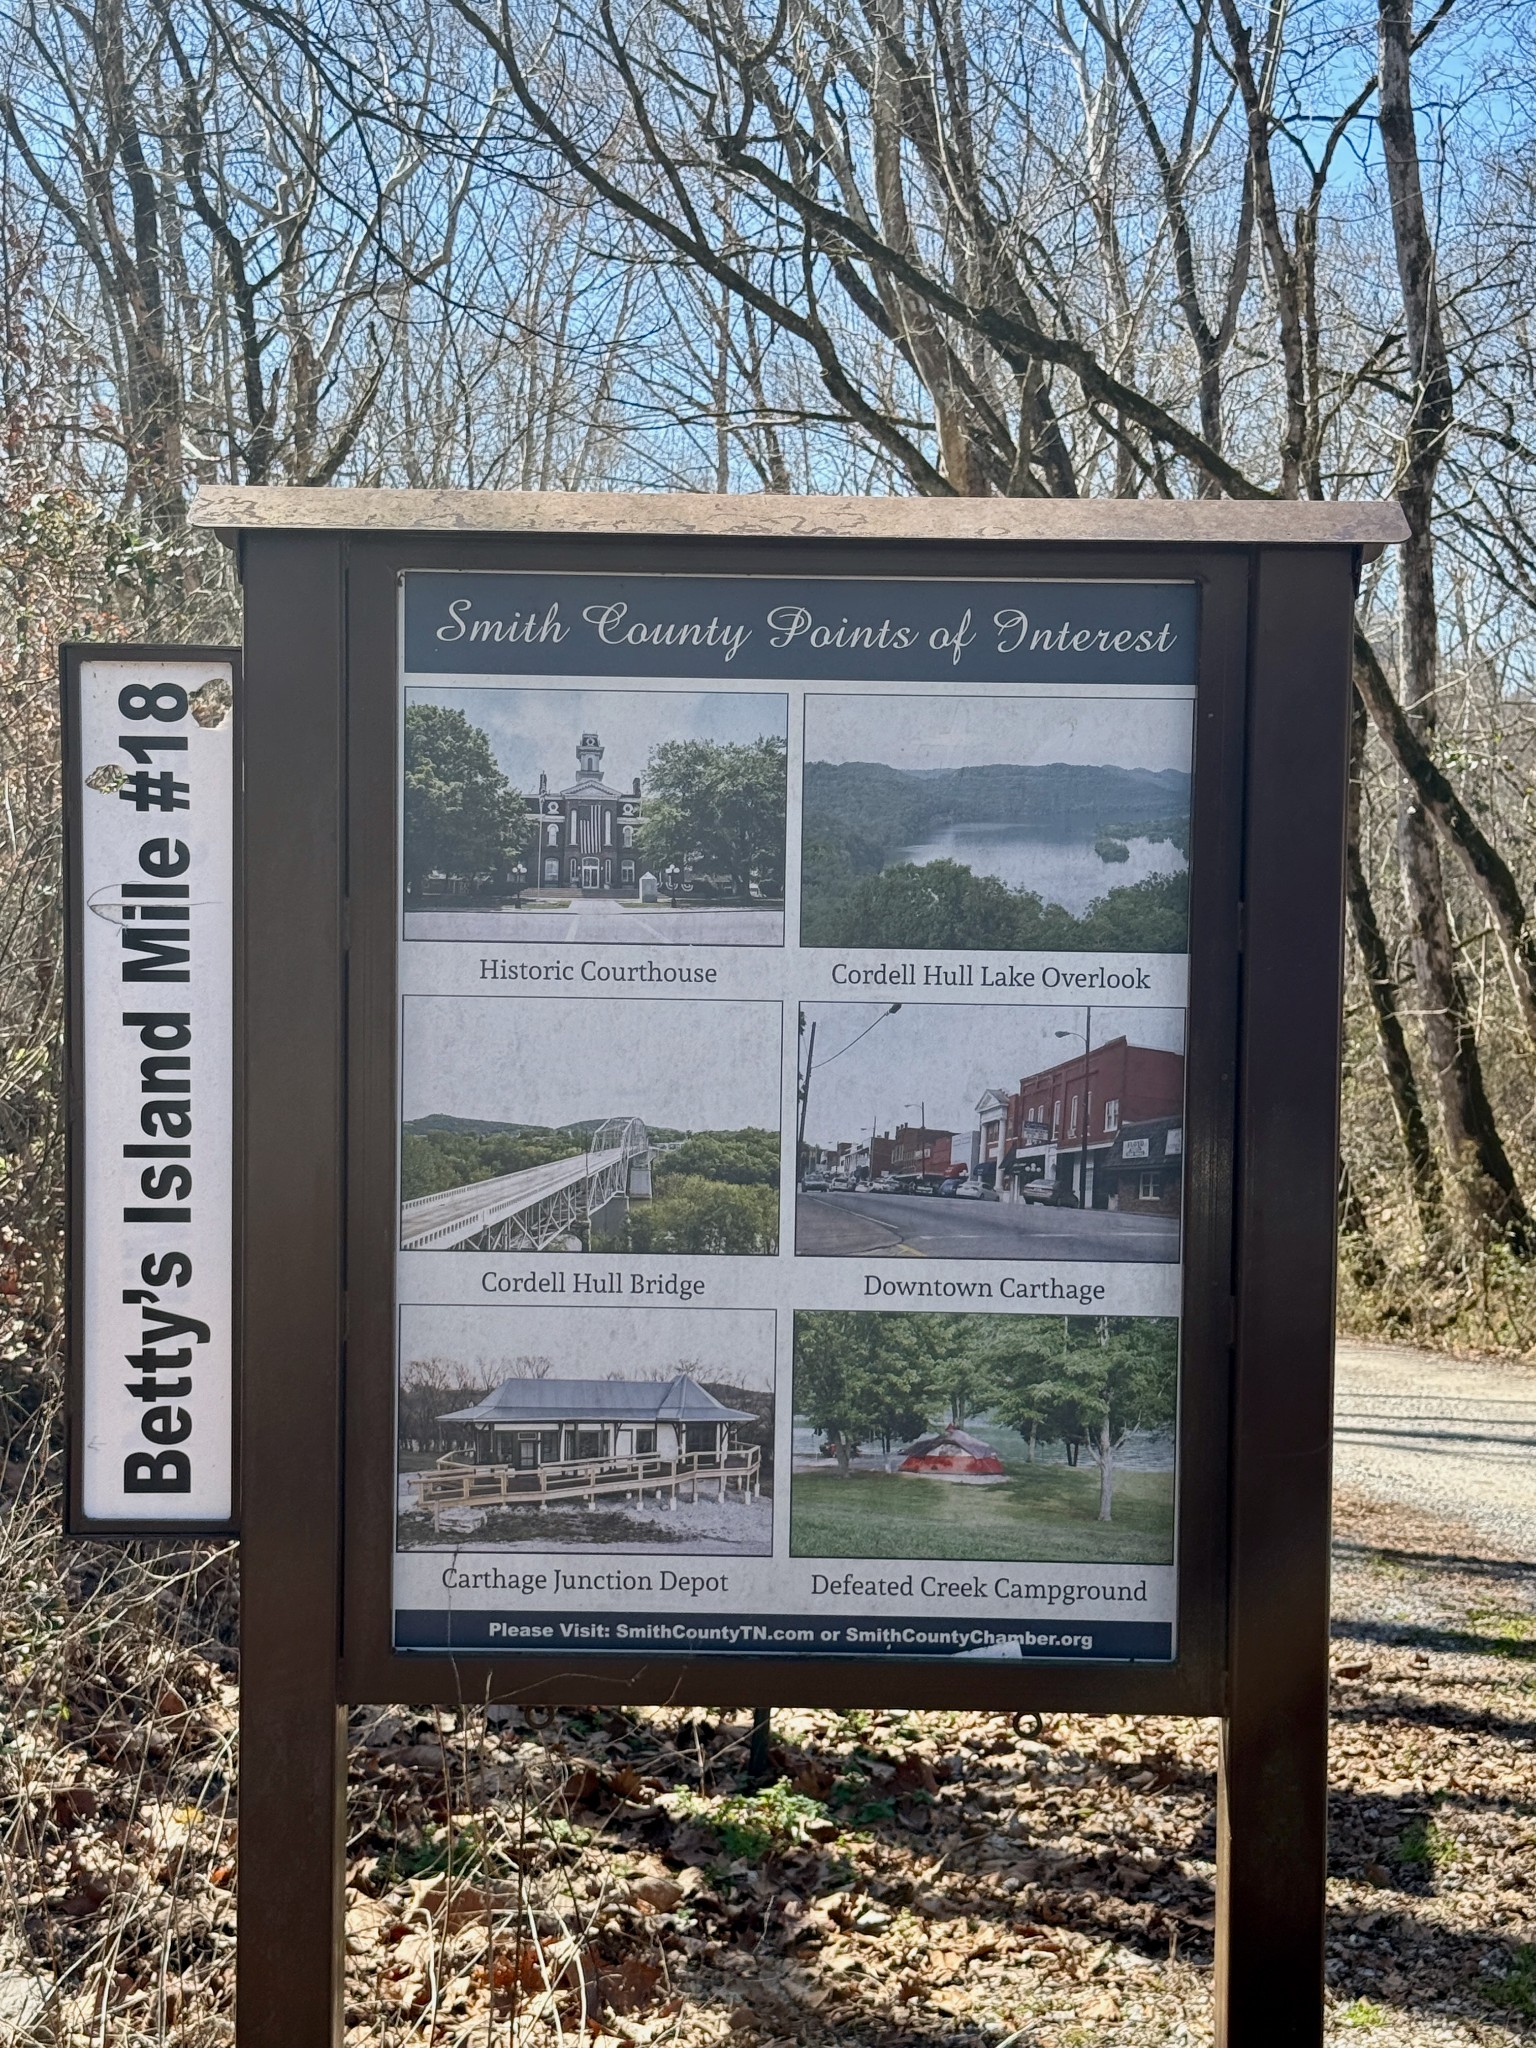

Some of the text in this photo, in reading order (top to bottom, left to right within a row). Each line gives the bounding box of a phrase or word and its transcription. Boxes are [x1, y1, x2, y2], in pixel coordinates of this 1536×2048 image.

[435, 598, 1178, 666] Smith County Points of Interest
[479, 958, 718, 984] Historic Courthouse
[831, 962, 1152, 990] Cordell Hull Lake Overlook
[118, 682, 211, 1494] Betty’s Island Mile #18
[481, 1270, 706, 1301] Cordell Hull Bridge
[863, 1274, 1106, 1306] Downtown Carthage
[441, 1567, 730, 1598] Carthage Junction Depot
[810, 1573, 1149, 1606] Defeated Creek Campground
[488, 1621, 1094, 1651] Please Visit: SmithCountyTN.com or SmithCountyChamber.org
